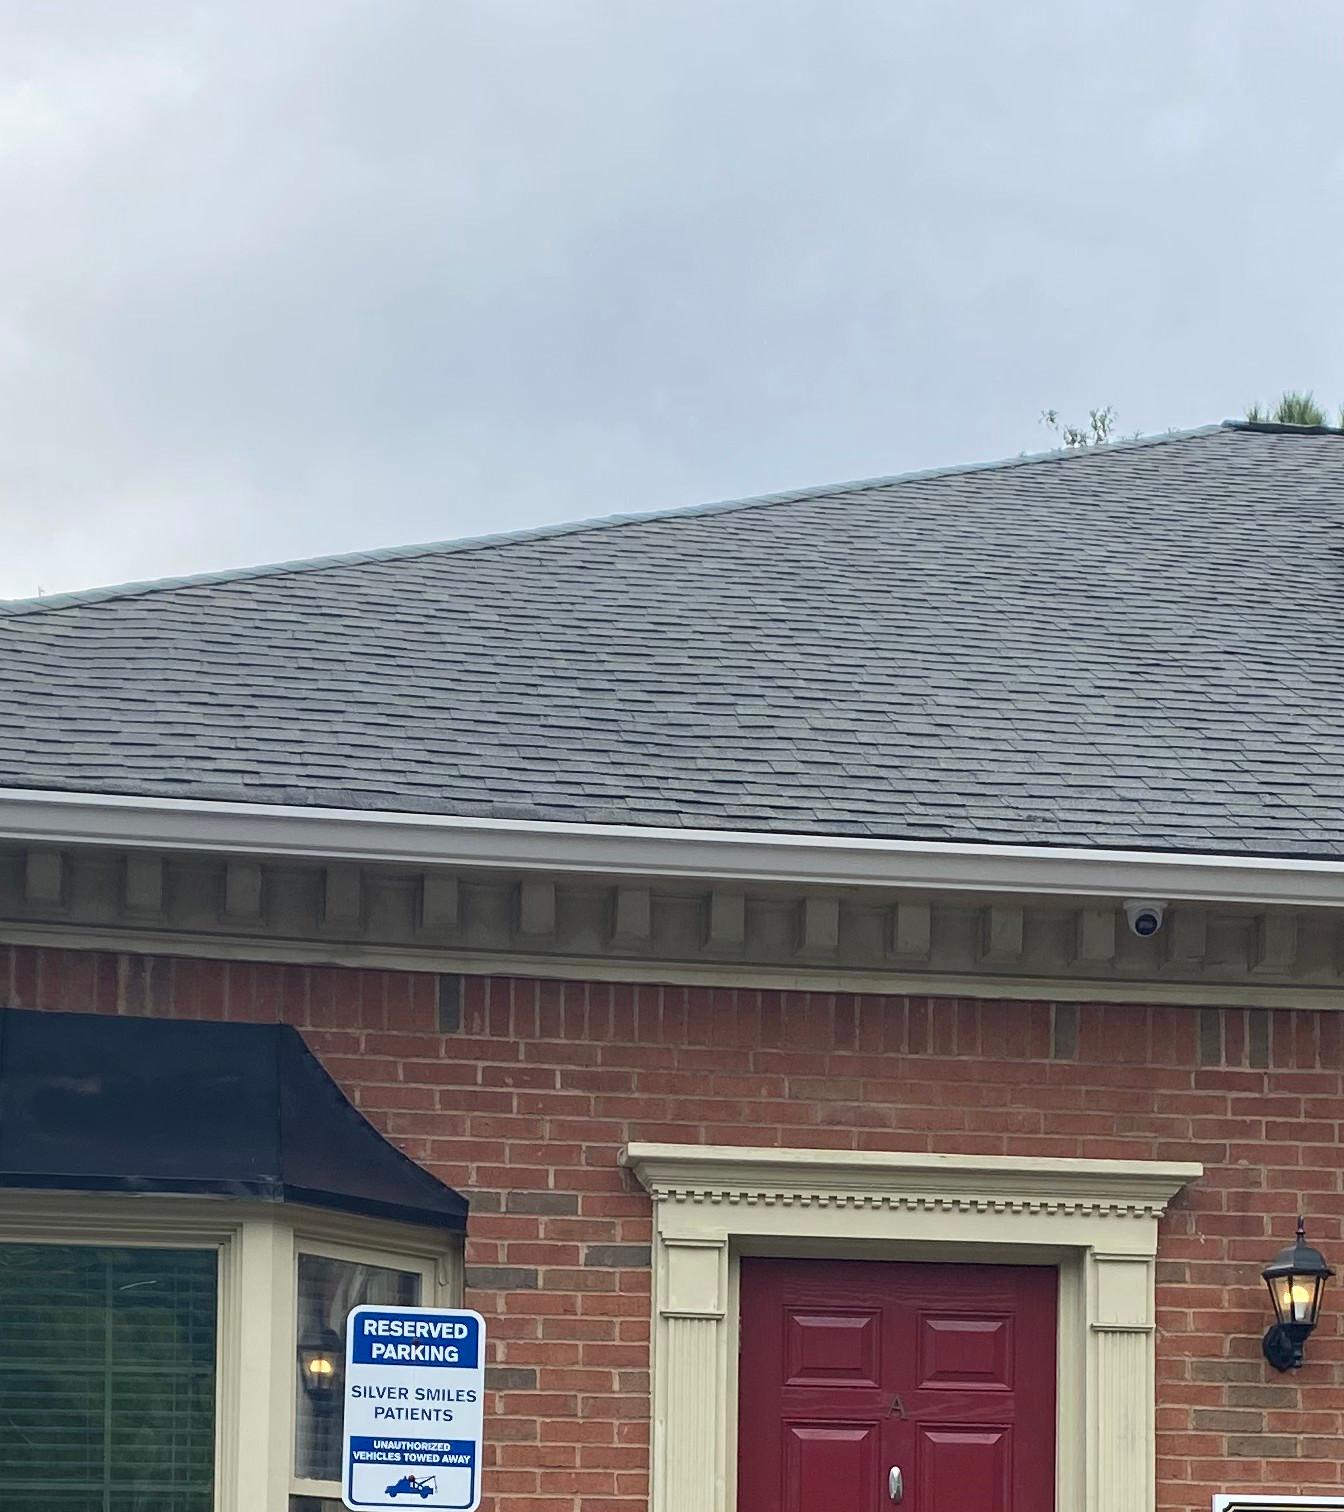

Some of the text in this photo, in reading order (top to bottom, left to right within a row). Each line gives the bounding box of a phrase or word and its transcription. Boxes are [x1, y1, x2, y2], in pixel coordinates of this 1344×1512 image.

[364, 1320, 467, 1339] RESERVED
[372, 1344, 459, 1362] PARKING
[352, 1386, 476, 1402] SILVER SMILES
[375, 1407, 453, 1421] PATIENTS
[374, 1440, 450, 1451] UNAUTHORIZED
[353, 1452, 471, 1464] VEHICLES TOWED AWAY
